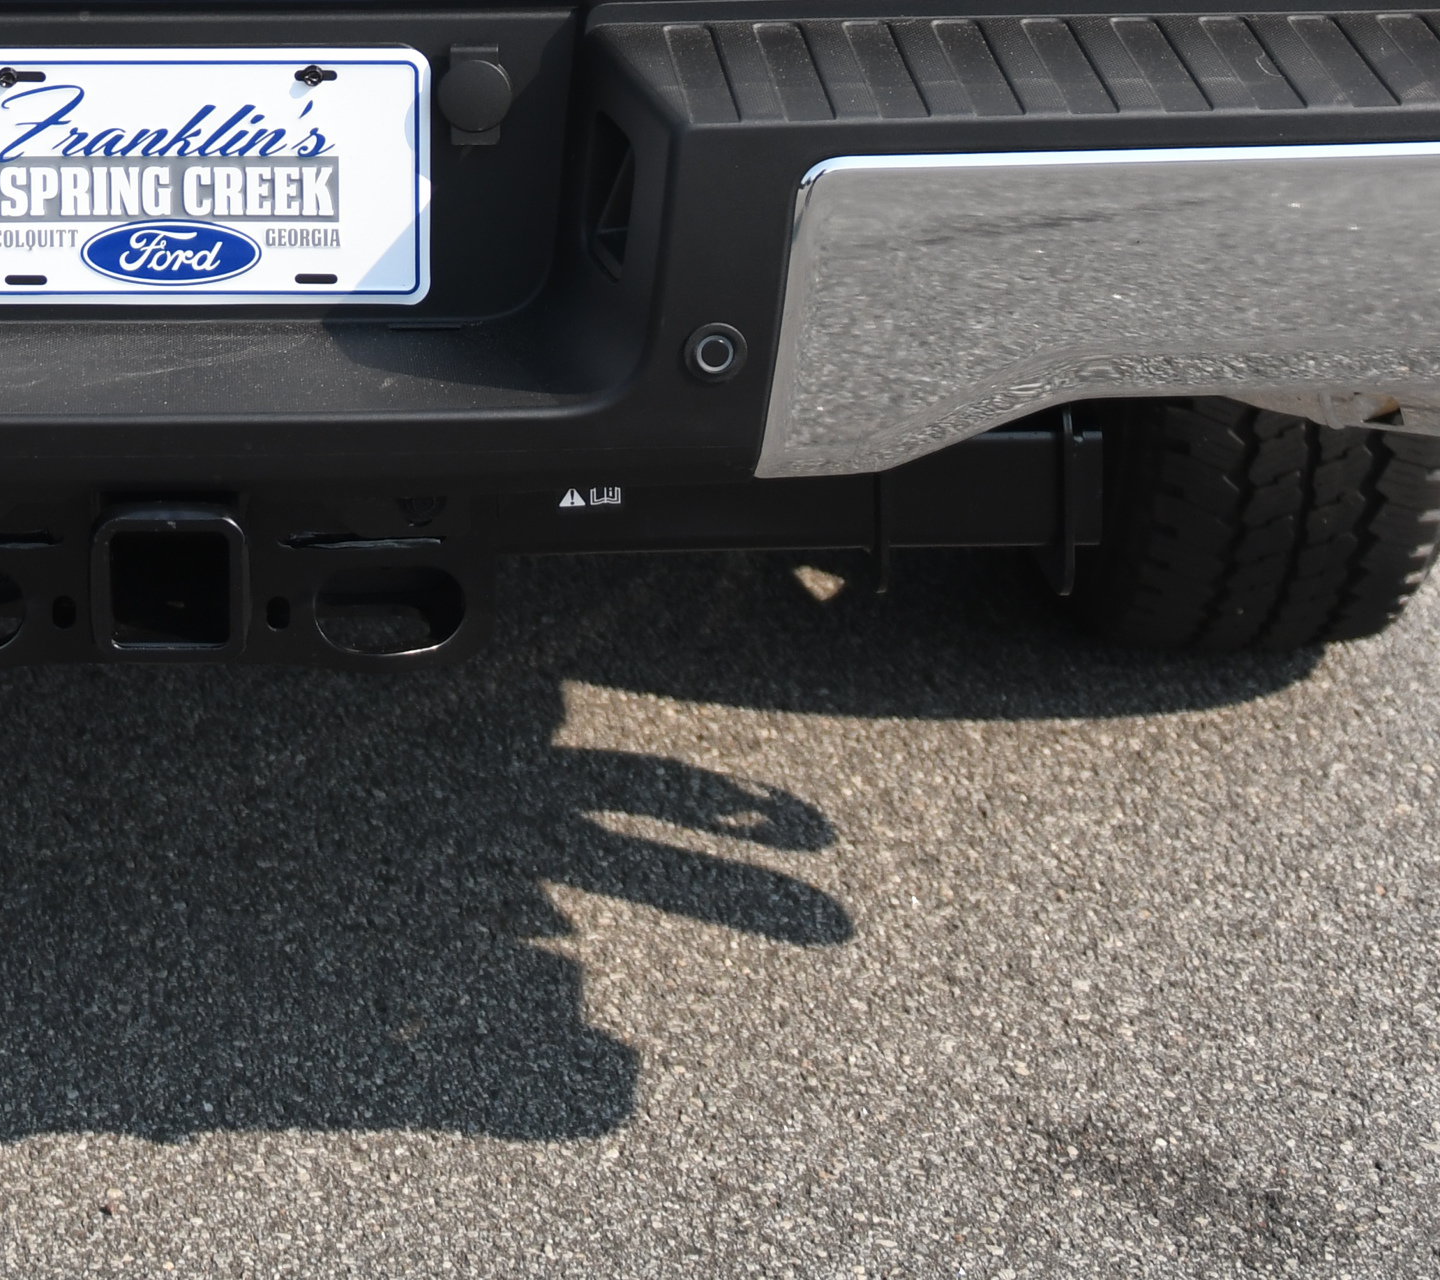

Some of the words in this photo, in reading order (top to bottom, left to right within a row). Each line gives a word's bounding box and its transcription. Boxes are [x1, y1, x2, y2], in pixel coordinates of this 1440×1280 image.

[182, 165, 335, 217] CREEK
[119, 229, 223, 273] Ford
[264, 227, 342, 248] GEORGIA
